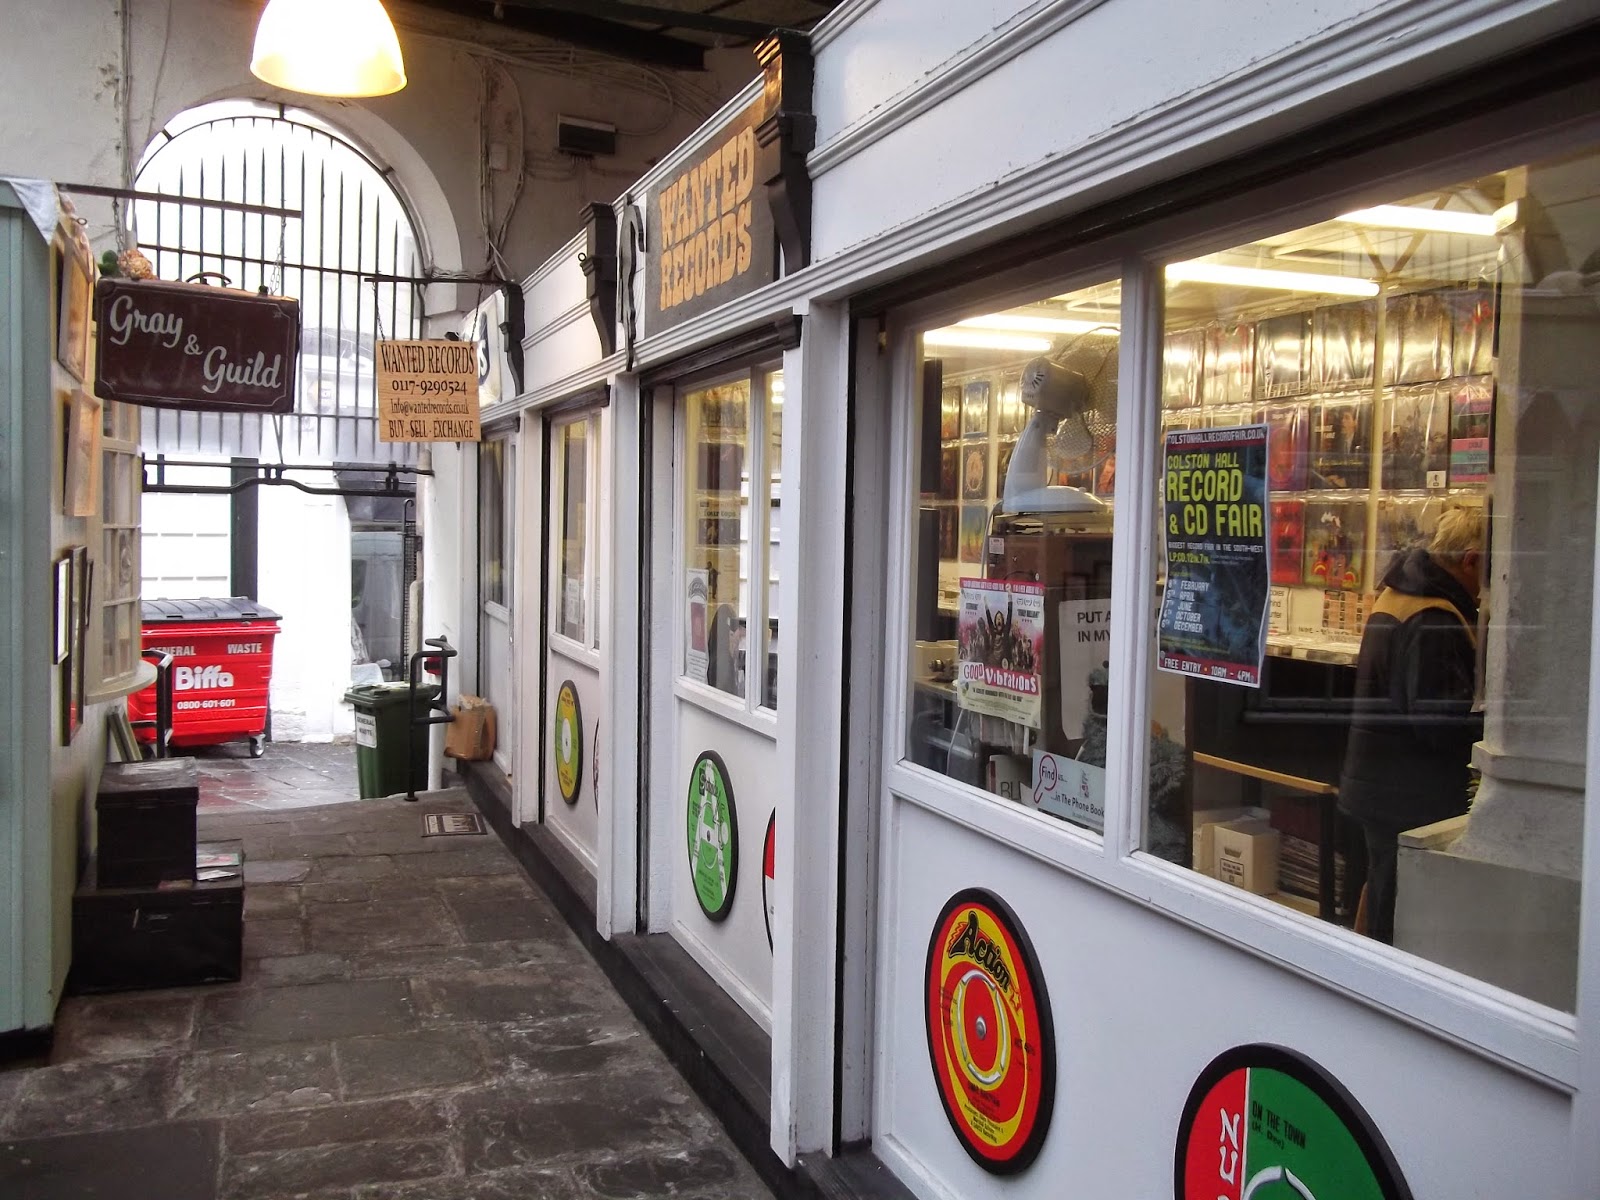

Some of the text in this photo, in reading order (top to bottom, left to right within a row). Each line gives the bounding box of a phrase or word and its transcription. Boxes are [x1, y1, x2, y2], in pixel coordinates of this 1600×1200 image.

[659, 125, 754, 250] WANTED
[660, 200, 752, 311] RECORDS
[109, 295, 281, 394] Gray & Guild
[380, 344, 425, 374] WANTED
[427, 345, 475, 374] RECORDS
[391, 380, 468, 395] 0117-9290524
[389, 420, 405, 438] BUY
[410, 420, 428, 438] SELL
[433, 420, 474, 438] EXCHANGE
[1167, 452, 1240, 470] COLSTON HALL
[1167, 469, 1243, 502] RECORD
[1169, 504, 1263, 537] & CD FAIR
[1180, 580, 1210, 592] FEBRUARY
[1179, 591, 1195, 601] APRIL
[1177, 601, 1193, 611] JUNE
[1077, 611, 1103, 624] PUT
[1175, 611, 1201, 622] OCTOBER
[1173, 620, 1203, 633] DECEMBER
[1078, 631, 1091, 642] IN
[227, 643, 263, 654] WASTE
[175, 665, 234, 691] Biffa
[963, 662, 984, 680] GOOD
[1164, 657, 1179, 669] FREE
[1181, 660, 1201, 673] ENTRY
[1211, 665, 1227, 678] 10AM
[1237, 670, 1251, 681] 4PM
[177, 699, 236, 710] 0800-601-601
[1041, 765, 1055, 780] Find
[1061, 794, 1071, 806] The
[1072, 797, 1089, 810] Phone
[1090, 803, 1104, 818] Book
[949, 911, 1011, 993] Action
[1252, 1100, 1263, 1121] ON
[1266, 1109, 1280, 1133] THE
[1283, 1120, 1306, 1150] TOWN
